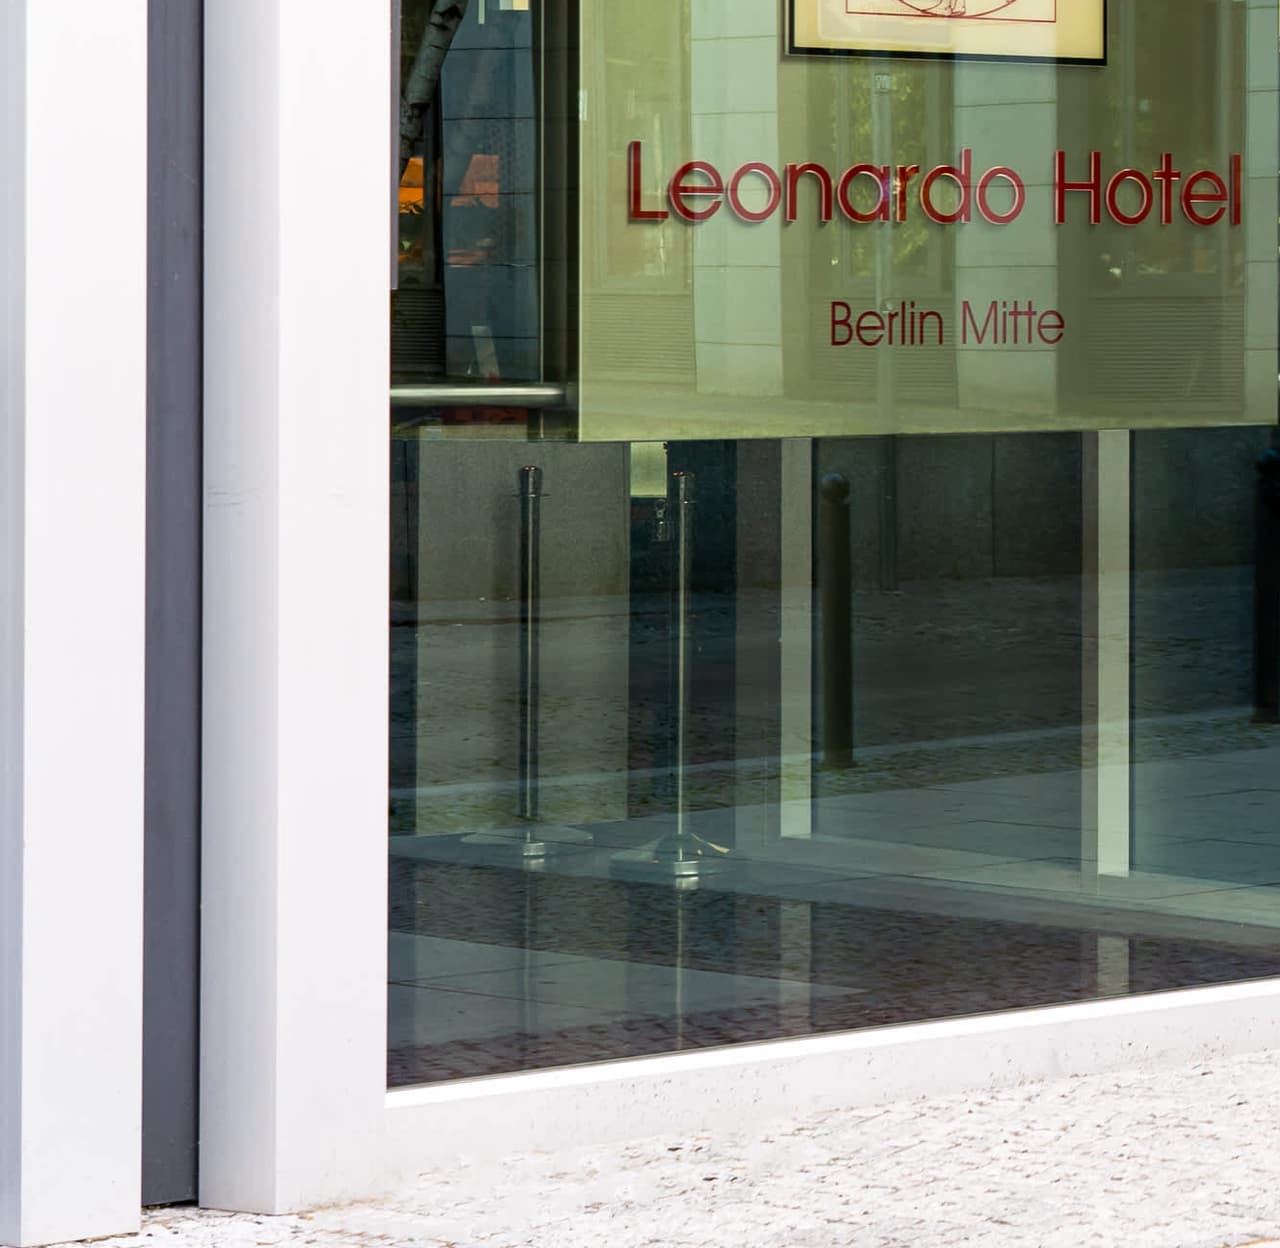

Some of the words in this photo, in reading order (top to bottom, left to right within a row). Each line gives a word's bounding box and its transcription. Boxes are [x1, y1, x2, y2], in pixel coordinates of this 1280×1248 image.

[630, 141, 1026, 226] Leonardo
[1053, 150, 1242, 227] Hotel
[830, 300, 944, 347] Berlin
[960, 300, 1065, 345] Mitte
